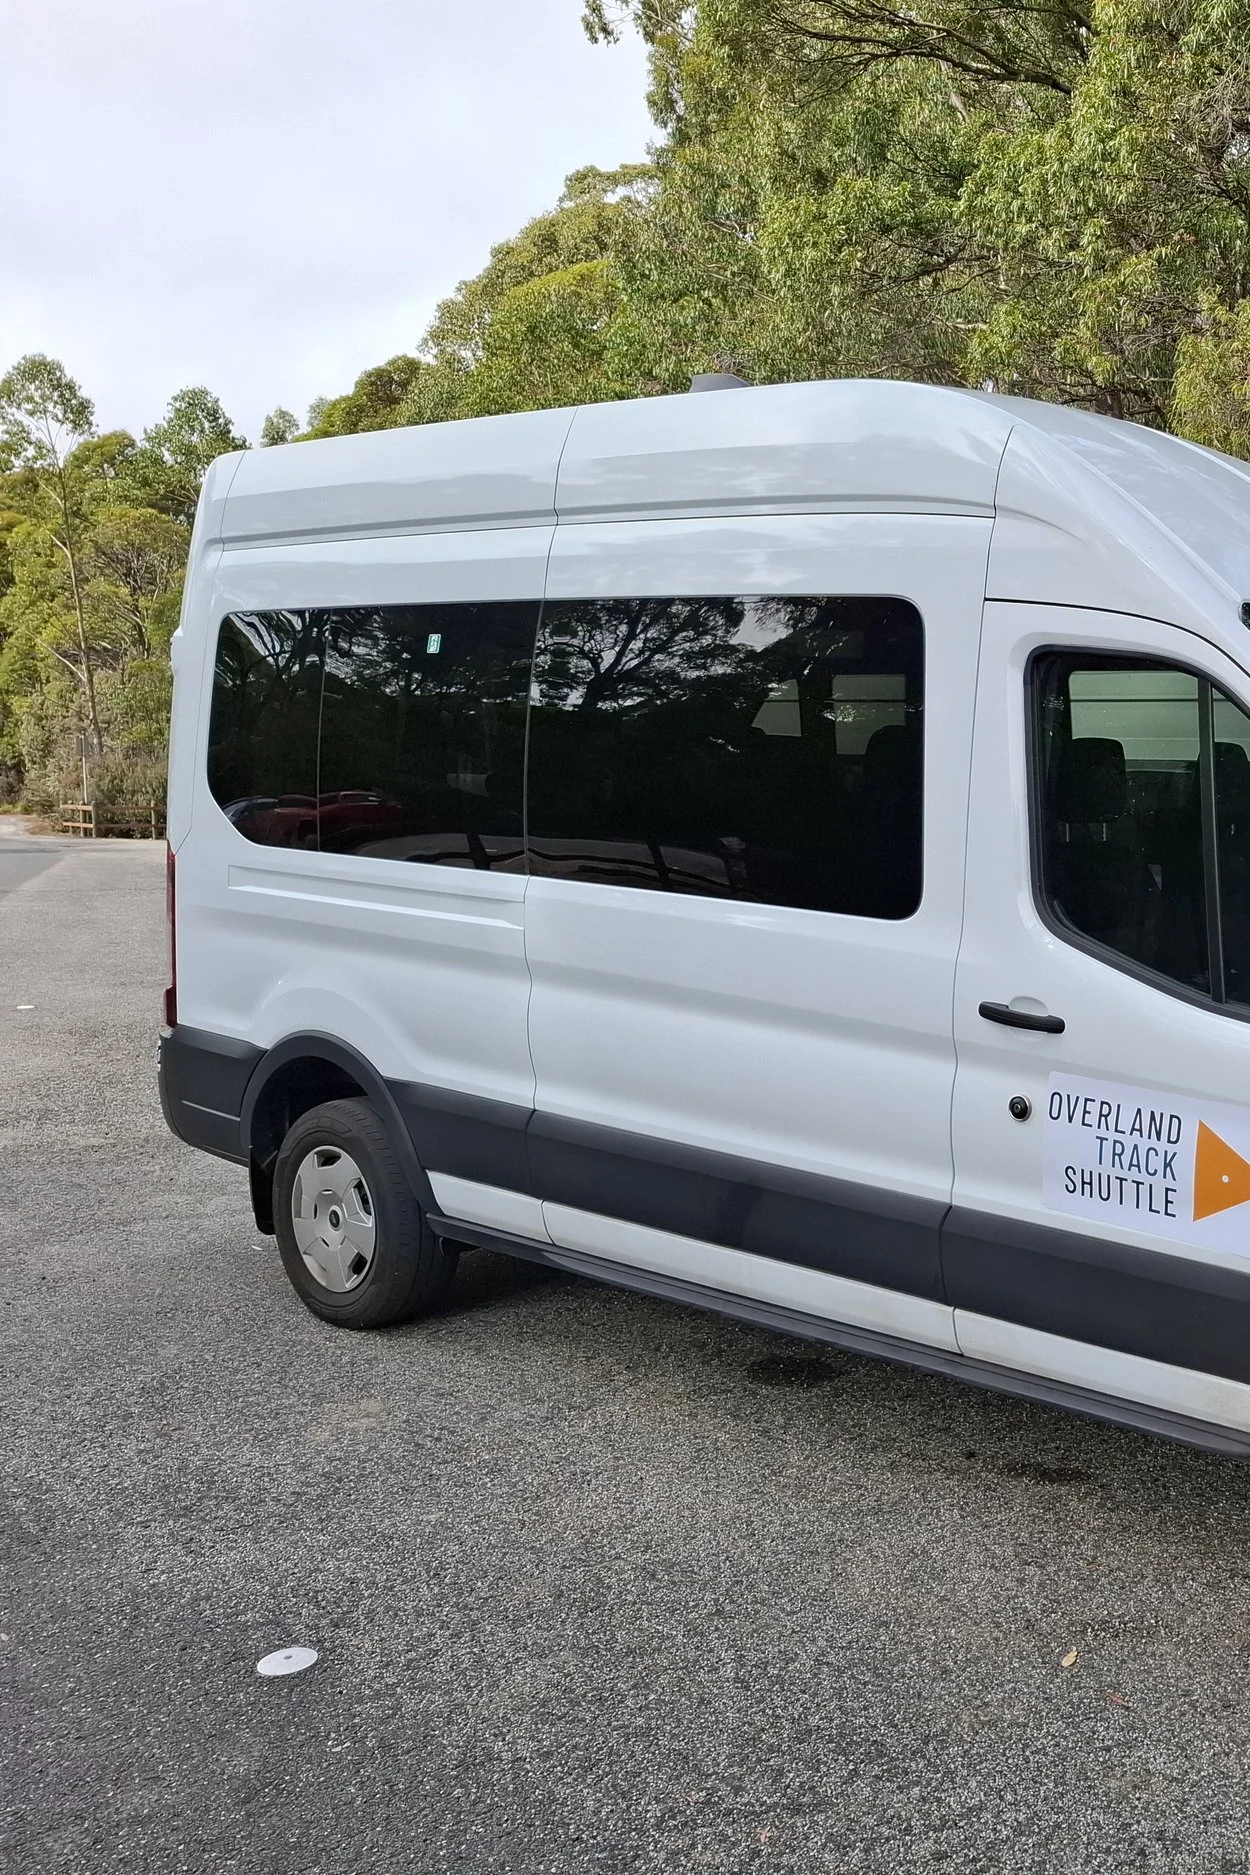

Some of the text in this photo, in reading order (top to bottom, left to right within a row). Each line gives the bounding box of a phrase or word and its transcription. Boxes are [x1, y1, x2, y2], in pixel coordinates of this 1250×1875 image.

[1048, 1091, 1182, 1144] OVERLAND
[1095, 1135, 1178, 1181] TRACK
[1064, 1165, 1177, 1218] SHUTTLE
